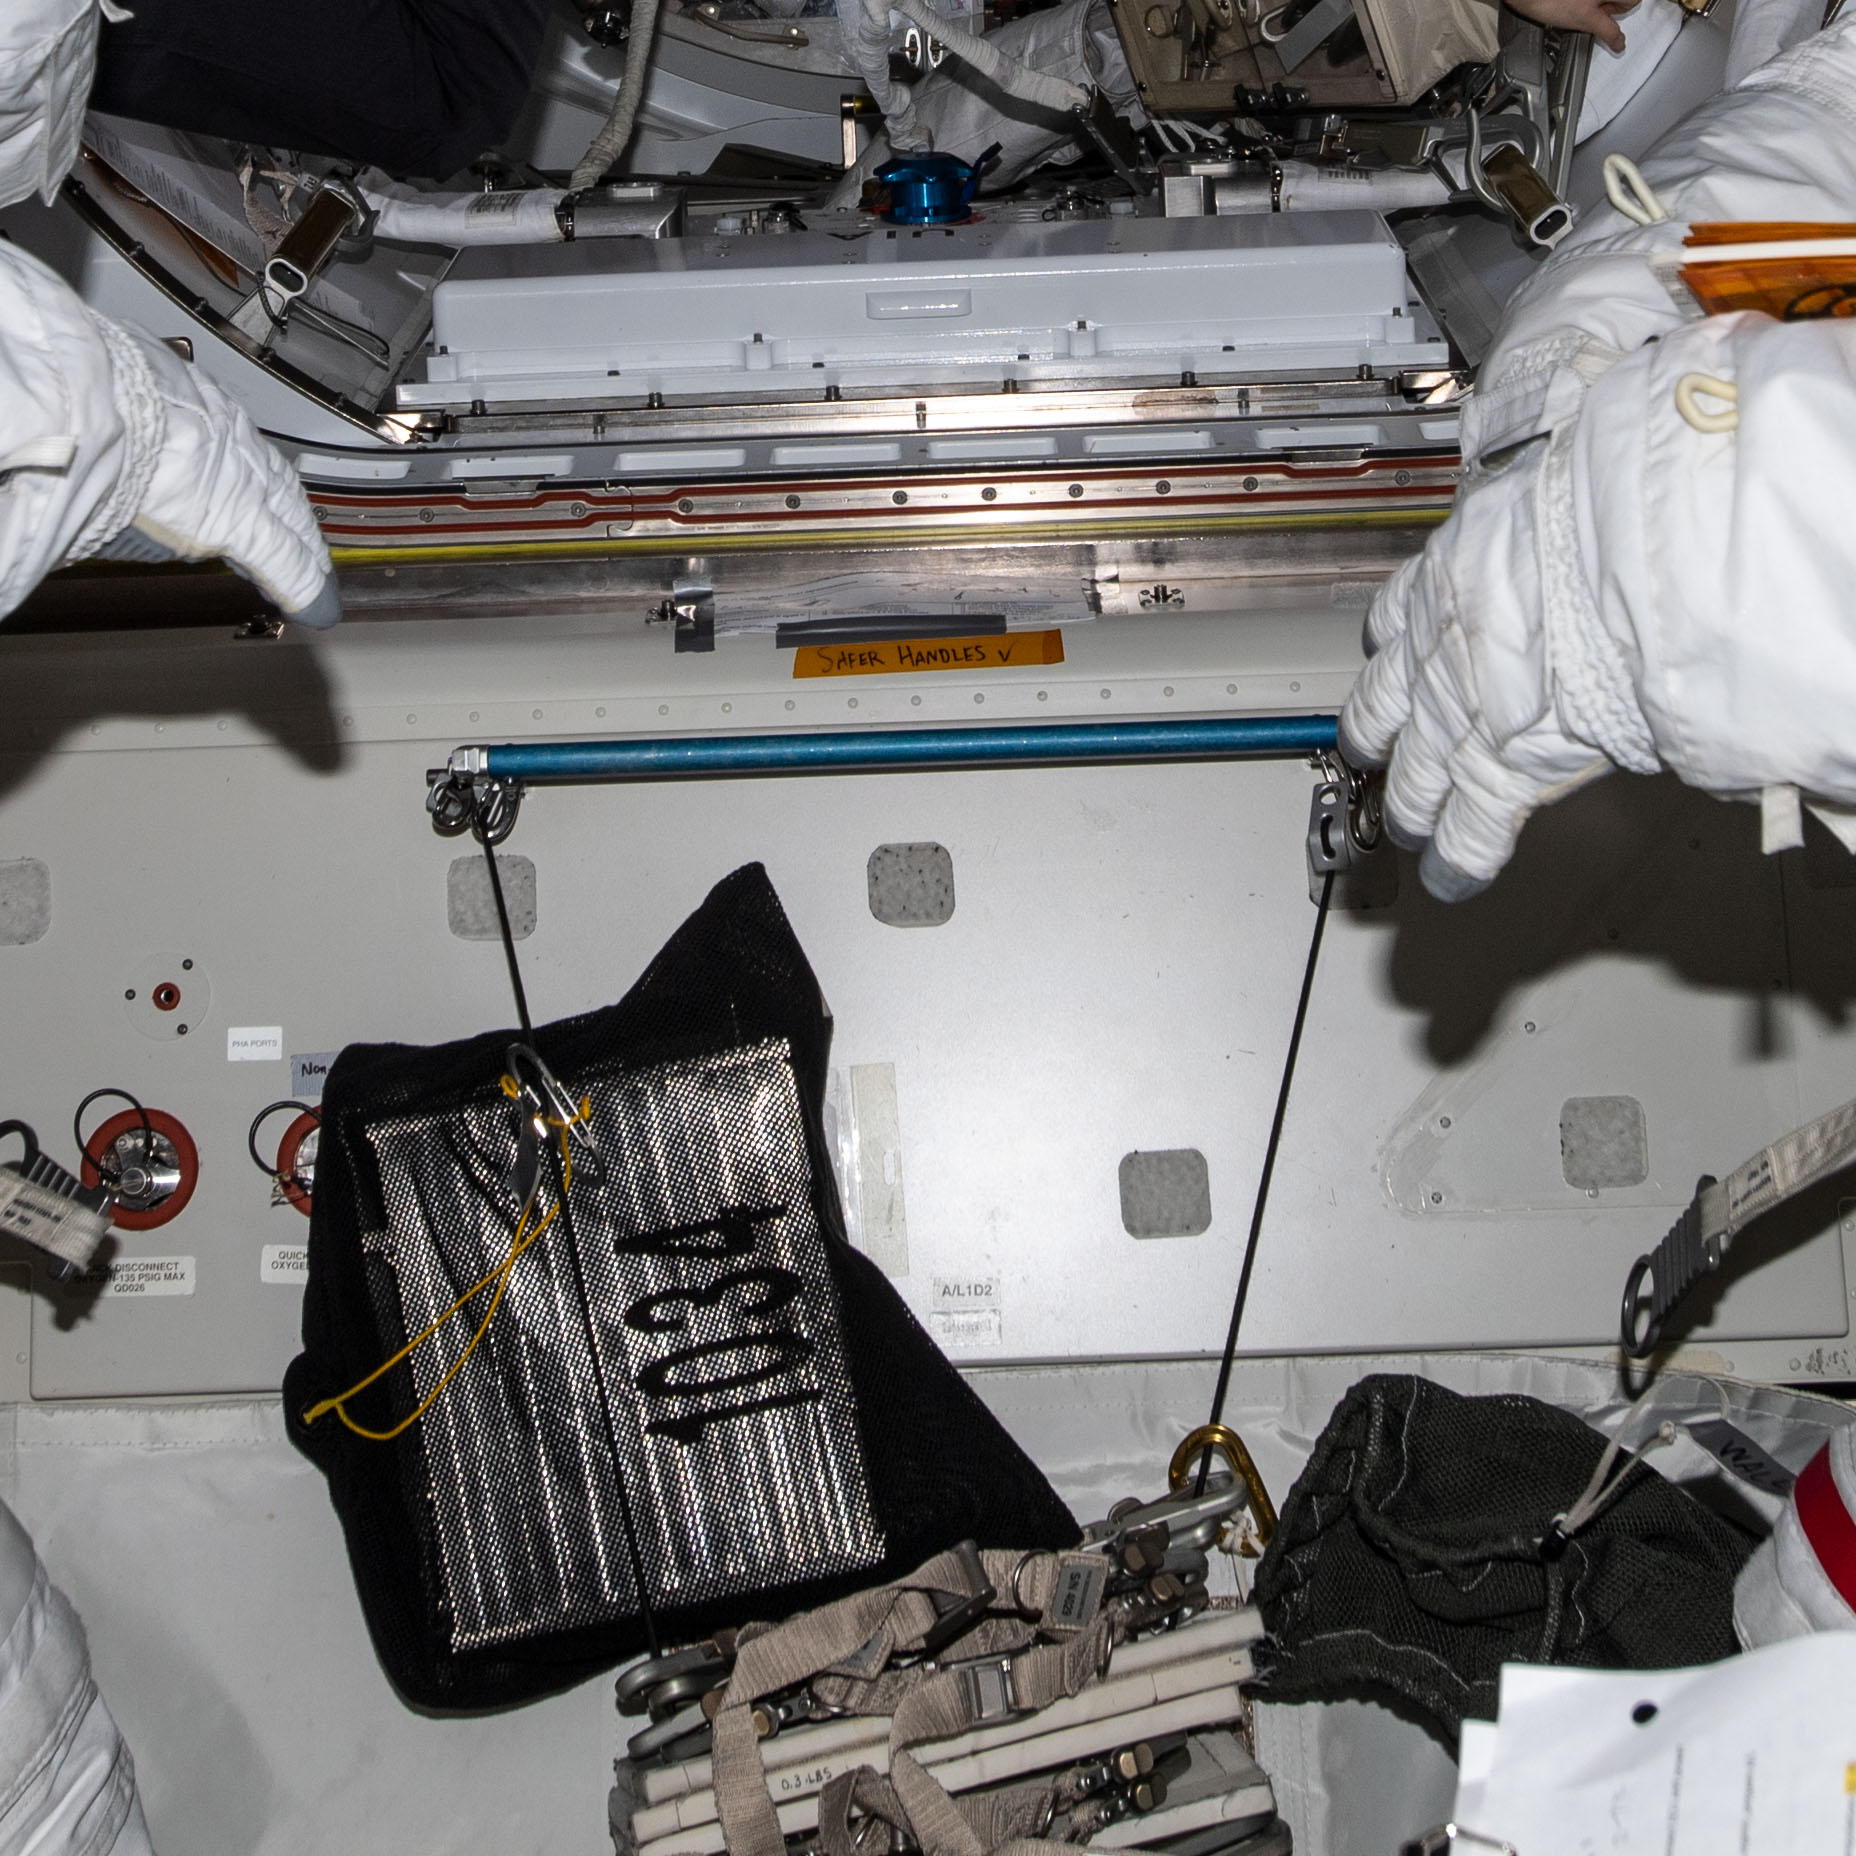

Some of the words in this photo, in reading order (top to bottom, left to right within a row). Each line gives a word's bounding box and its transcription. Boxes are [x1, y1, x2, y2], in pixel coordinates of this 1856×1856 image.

[817, 646, 885, 674] SAFER
[898, 645, 986, 667] HANDLES
[231, 1039, 249, 1048] PHA
[250, 1039, 278, 1048] PORTS
[114, 1262, 180, 1273] DISCONNECT
[138, 1272, 161, 1282] PSIG
[163, 1272, 186, 1281] MAX
[114, 1283, 145, 1293] QD026
[941, 1284, 993, 1298] A/L1D2
[613, 1202, 824, 1444] 1034
